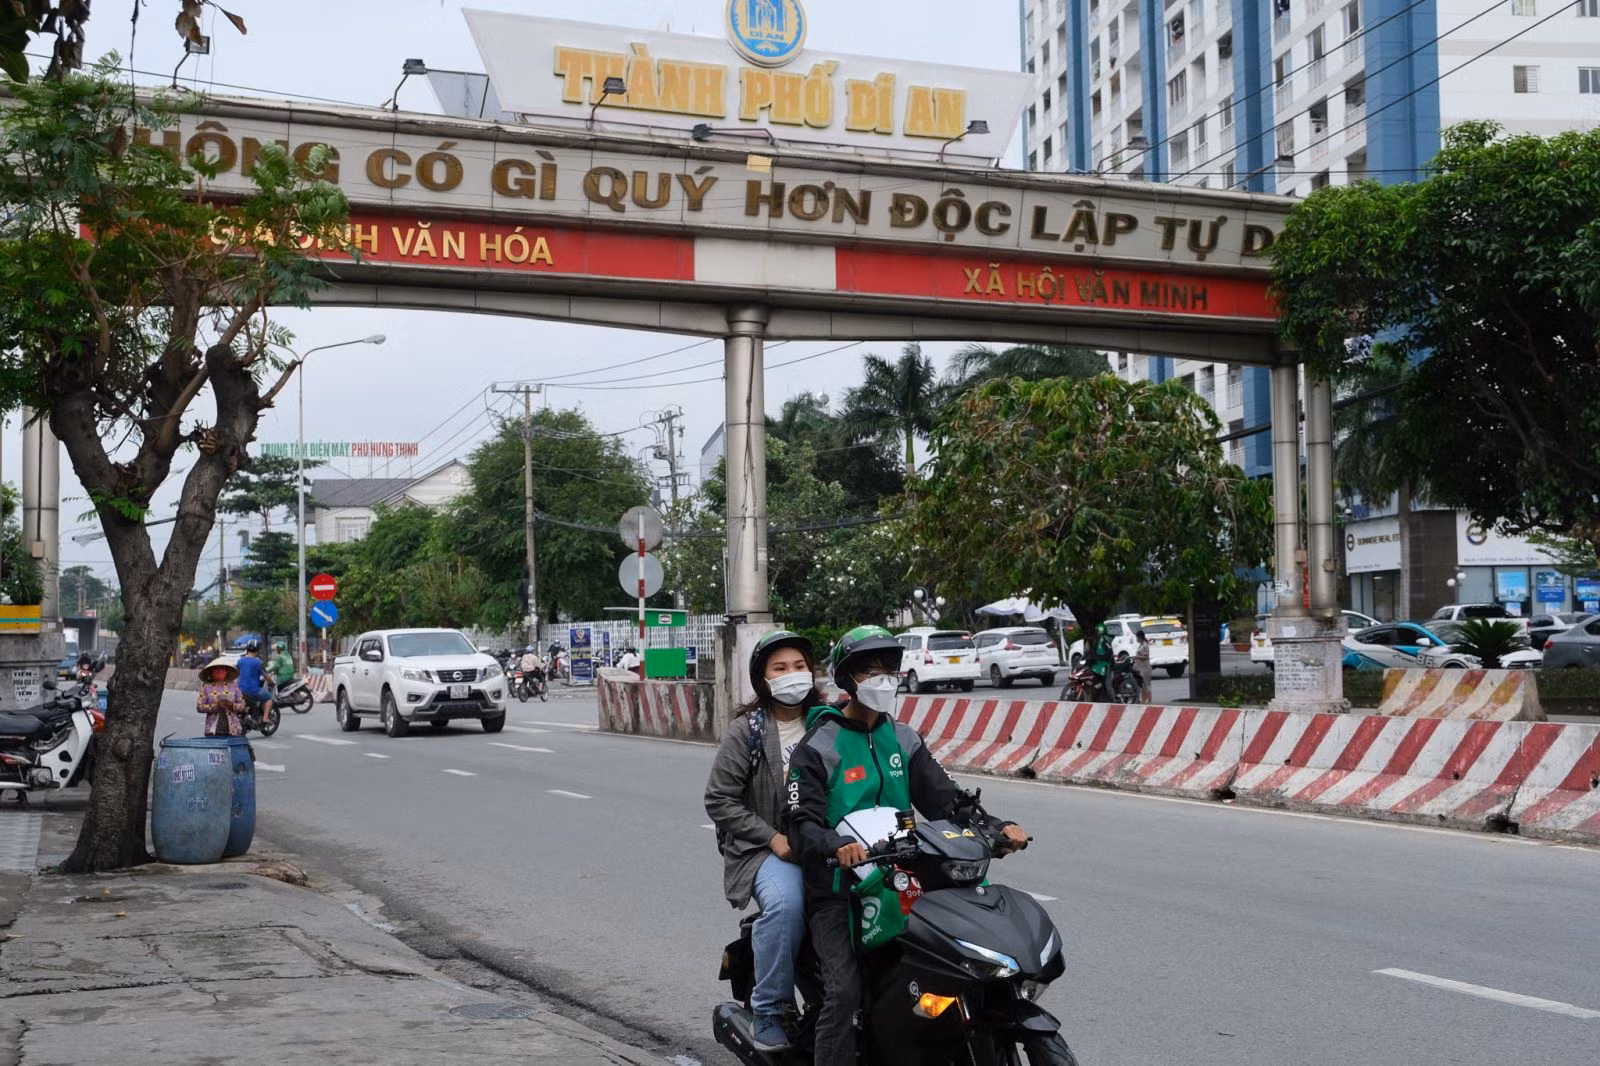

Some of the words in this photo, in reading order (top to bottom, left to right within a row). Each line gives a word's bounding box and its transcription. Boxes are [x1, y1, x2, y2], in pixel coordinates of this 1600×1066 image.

[553, 42, 728, 119] THÀNH
[738, 60, 838, 128] PHỐ
[903, 85, 966, 141] AN
[112, 119, 341, 186] HÔNG
[366, 141, 464, 191] CÓ
[491, 150, 558, 201] GÌ
[583, 166, 719, 213] QUÝ
[744, 180, 872, 225] HƠN
[889, 188, 1012, 242] ĐỘC
[1031, 200, 1139, 252] LẬP
[1154, 215, 1229, 262] TỰ
[392, 221, 466, 260] VĂN
[479, 227, 553, 265] HÓA
[962, 263, 1005, 296] XÃ
[1074, 269, 1130, 305] VĂN
[1140, 279, 1208, 311] MINH
[261, 443, 288, 457] TRUNG
[331, 440, 349, 457] MÁY
